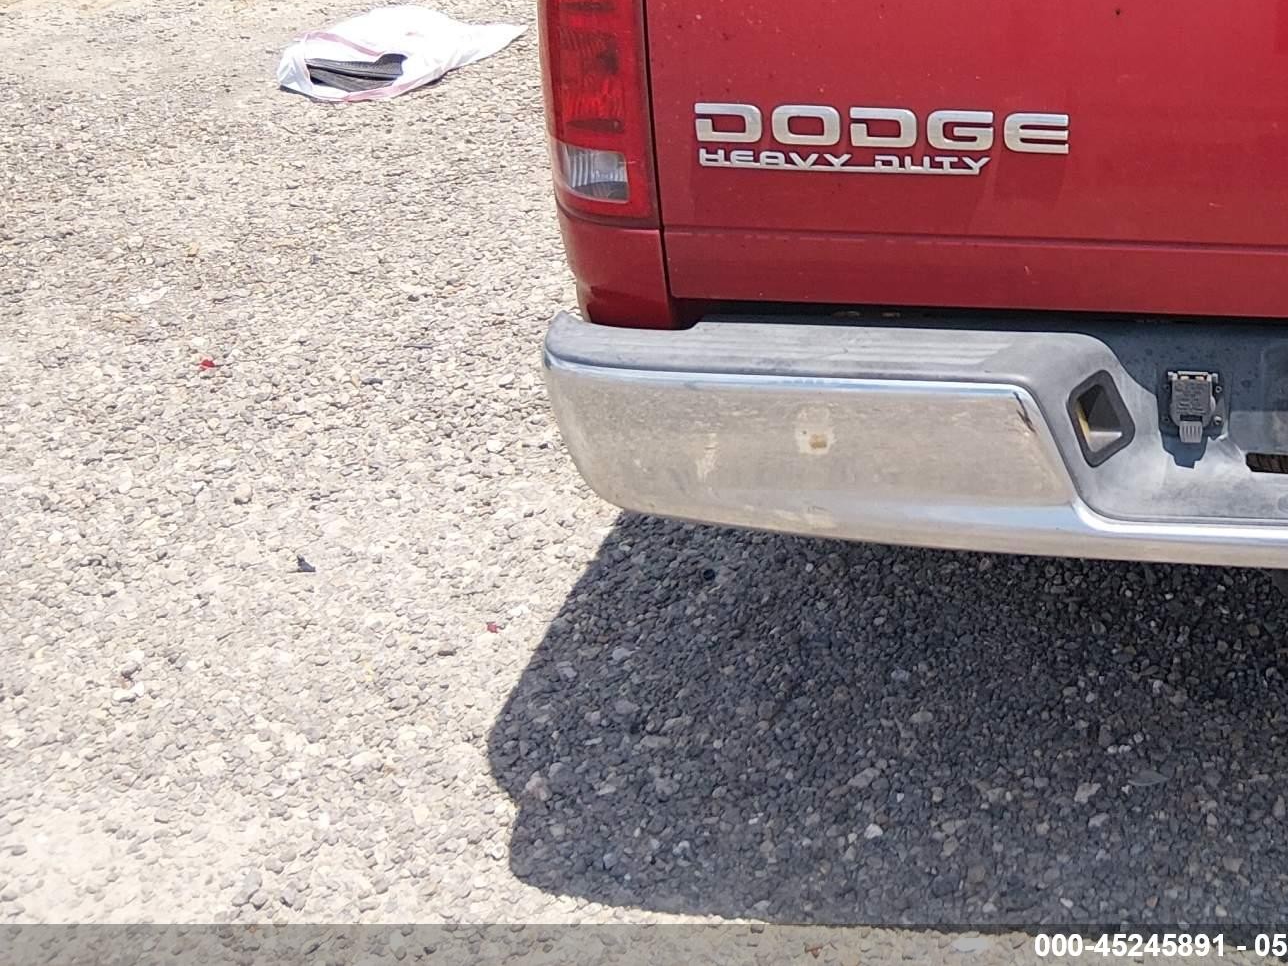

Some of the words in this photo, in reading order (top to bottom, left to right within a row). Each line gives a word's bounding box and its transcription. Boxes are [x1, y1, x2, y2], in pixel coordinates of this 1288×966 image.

[694, 102, 1069, 155] DODGE
[699, 148, 852, 169] HEAVY
[874, 154, 991, 174] DUTY
